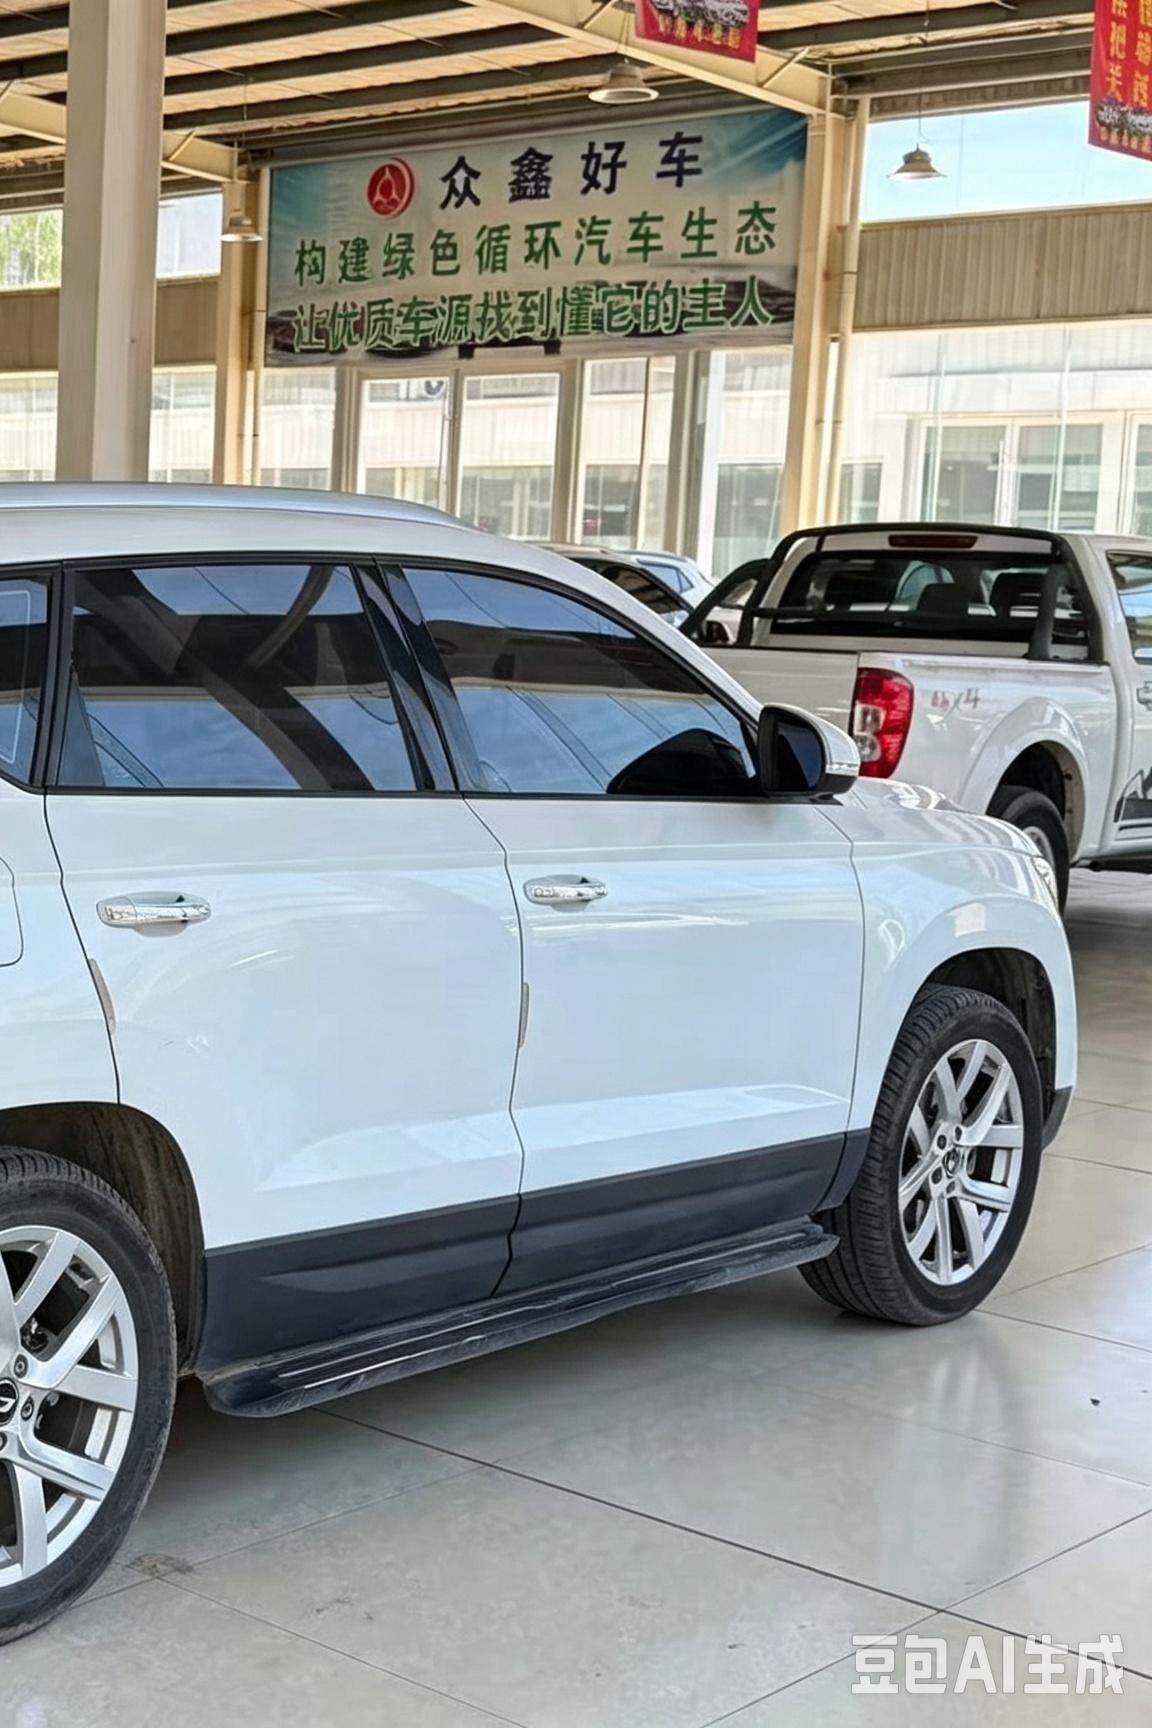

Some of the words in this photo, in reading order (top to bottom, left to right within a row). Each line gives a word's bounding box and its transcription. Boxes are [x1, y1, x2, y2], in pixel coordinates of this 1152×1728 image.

[439, 131, 704, 210] 众鑫好车
[294, 200, 777, 287] 构建绿色循环汽车生态
